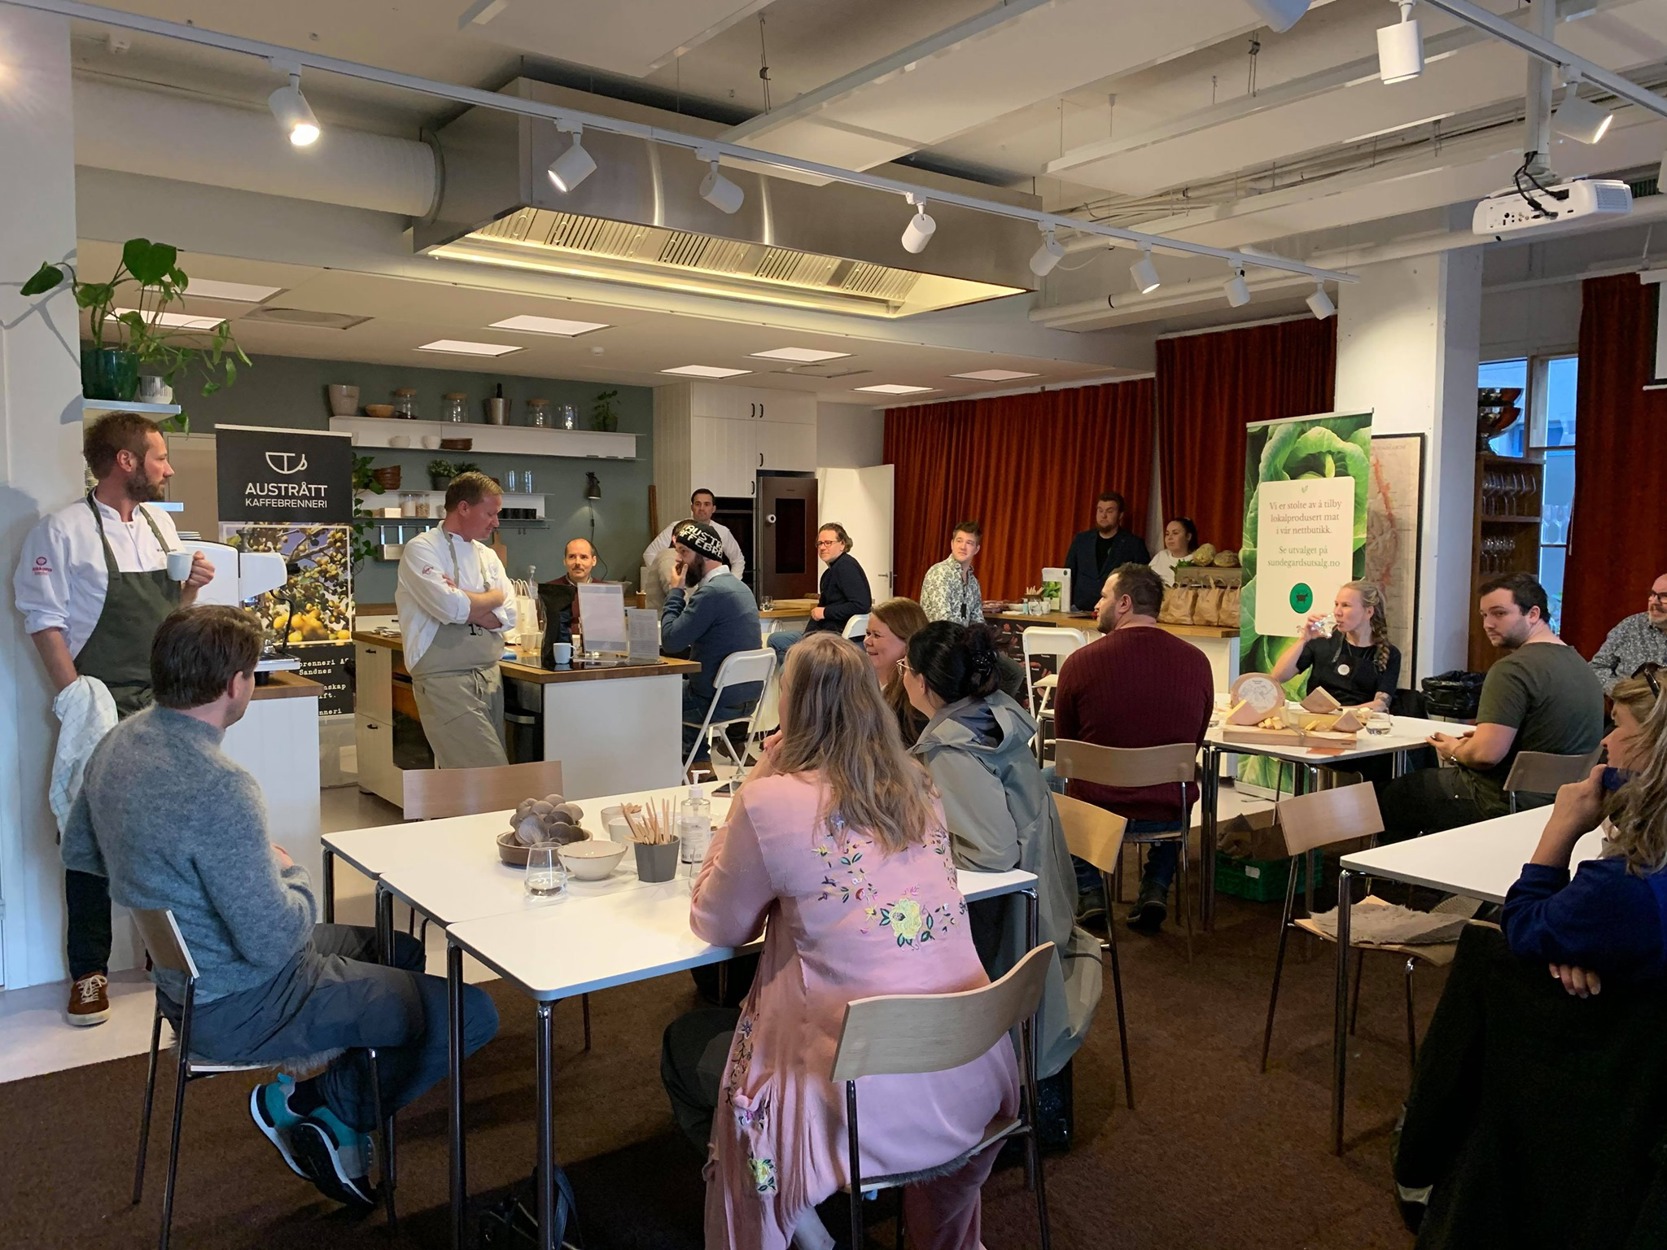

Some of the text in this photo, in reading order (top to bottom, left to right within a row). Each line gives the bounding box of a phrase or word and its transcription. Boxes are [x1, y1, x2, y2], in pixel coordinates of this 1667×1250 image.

[245, 481, 328, 497] AUSTRÅTT
[245, 498, 328, 508] KAFFEBRENNERI
[1269, 501, 1278, 510] Vi
[1287, 500, 1307, 510] stolte
[1324, 498, 1342, 510] tilby
[1270, 513, 1340, 524] lokalprodusert mat
[1279, 544, 1328, 556] Se utvalget på
[299, 668, 332, 676] Sandnes
